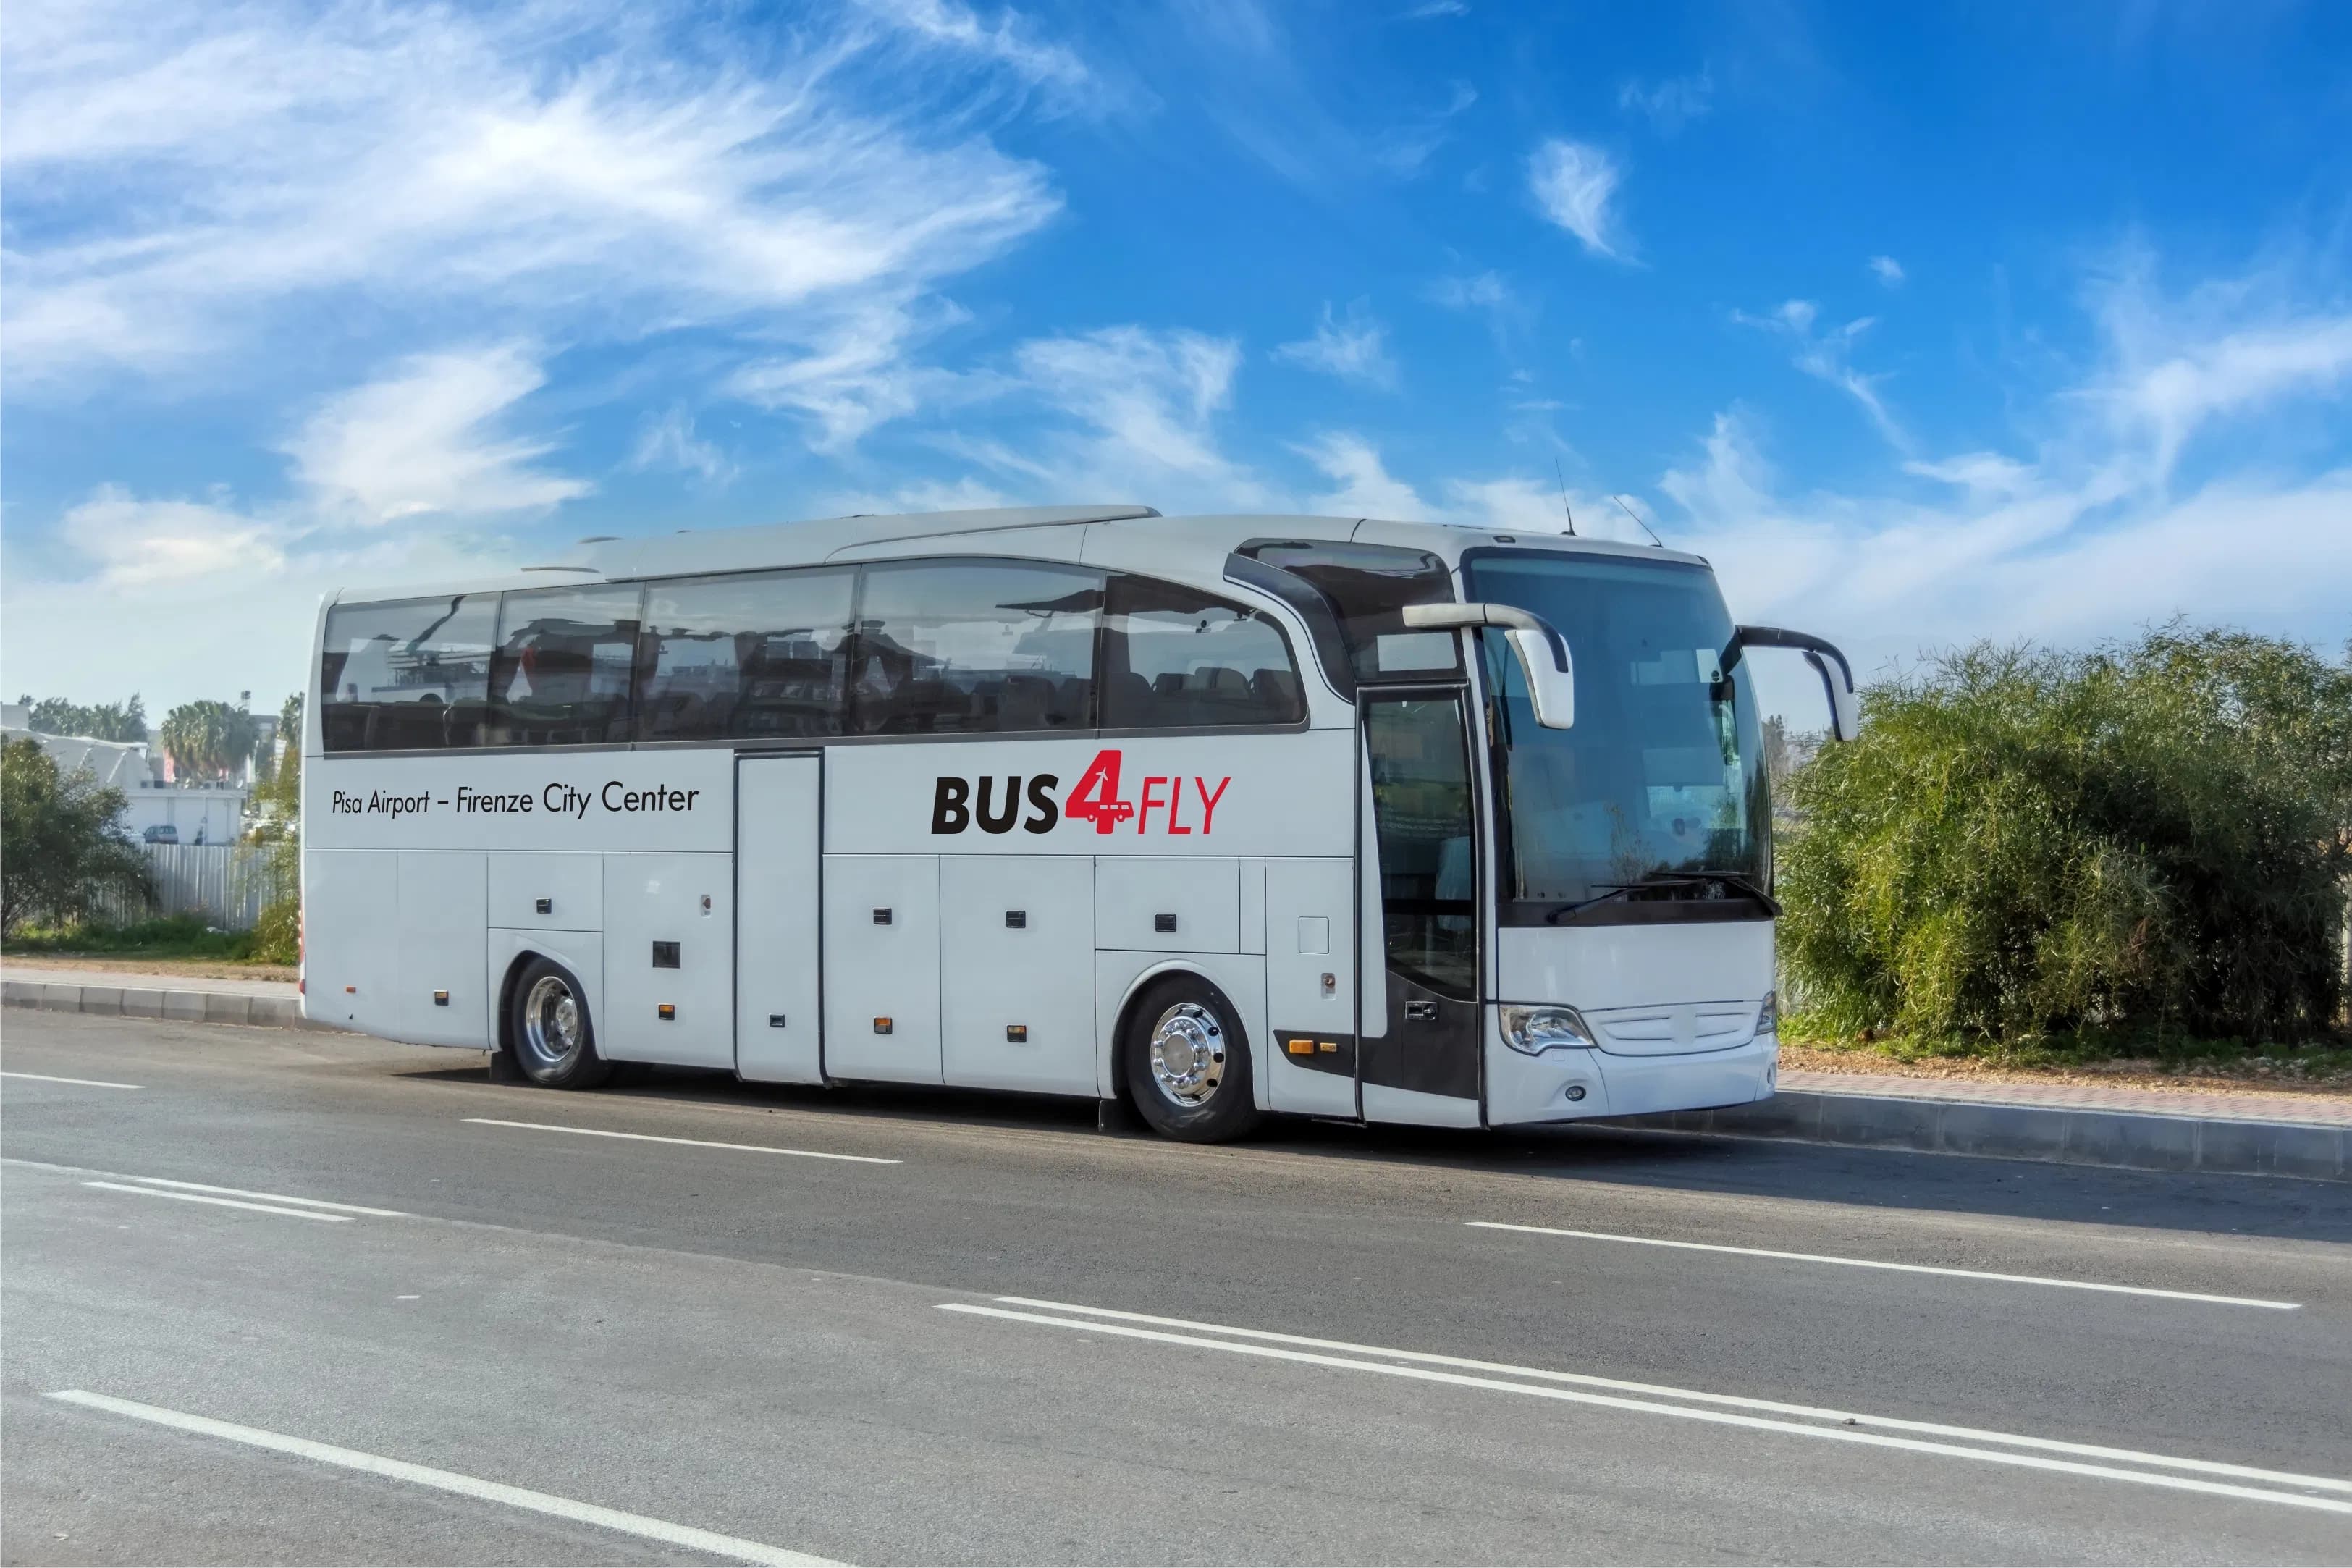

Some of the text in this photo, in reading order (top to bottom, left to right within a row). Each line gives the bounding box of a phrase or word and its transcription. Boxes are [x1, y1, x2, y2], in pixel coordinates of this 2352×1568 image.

[332, 791, 363, 814] Pisa
[367, 789, 430, 819] Airport
[456, 786, 534, 813] Firenze
[543, 783, 592, 820] City
[602, 780, 699, 812] Center
